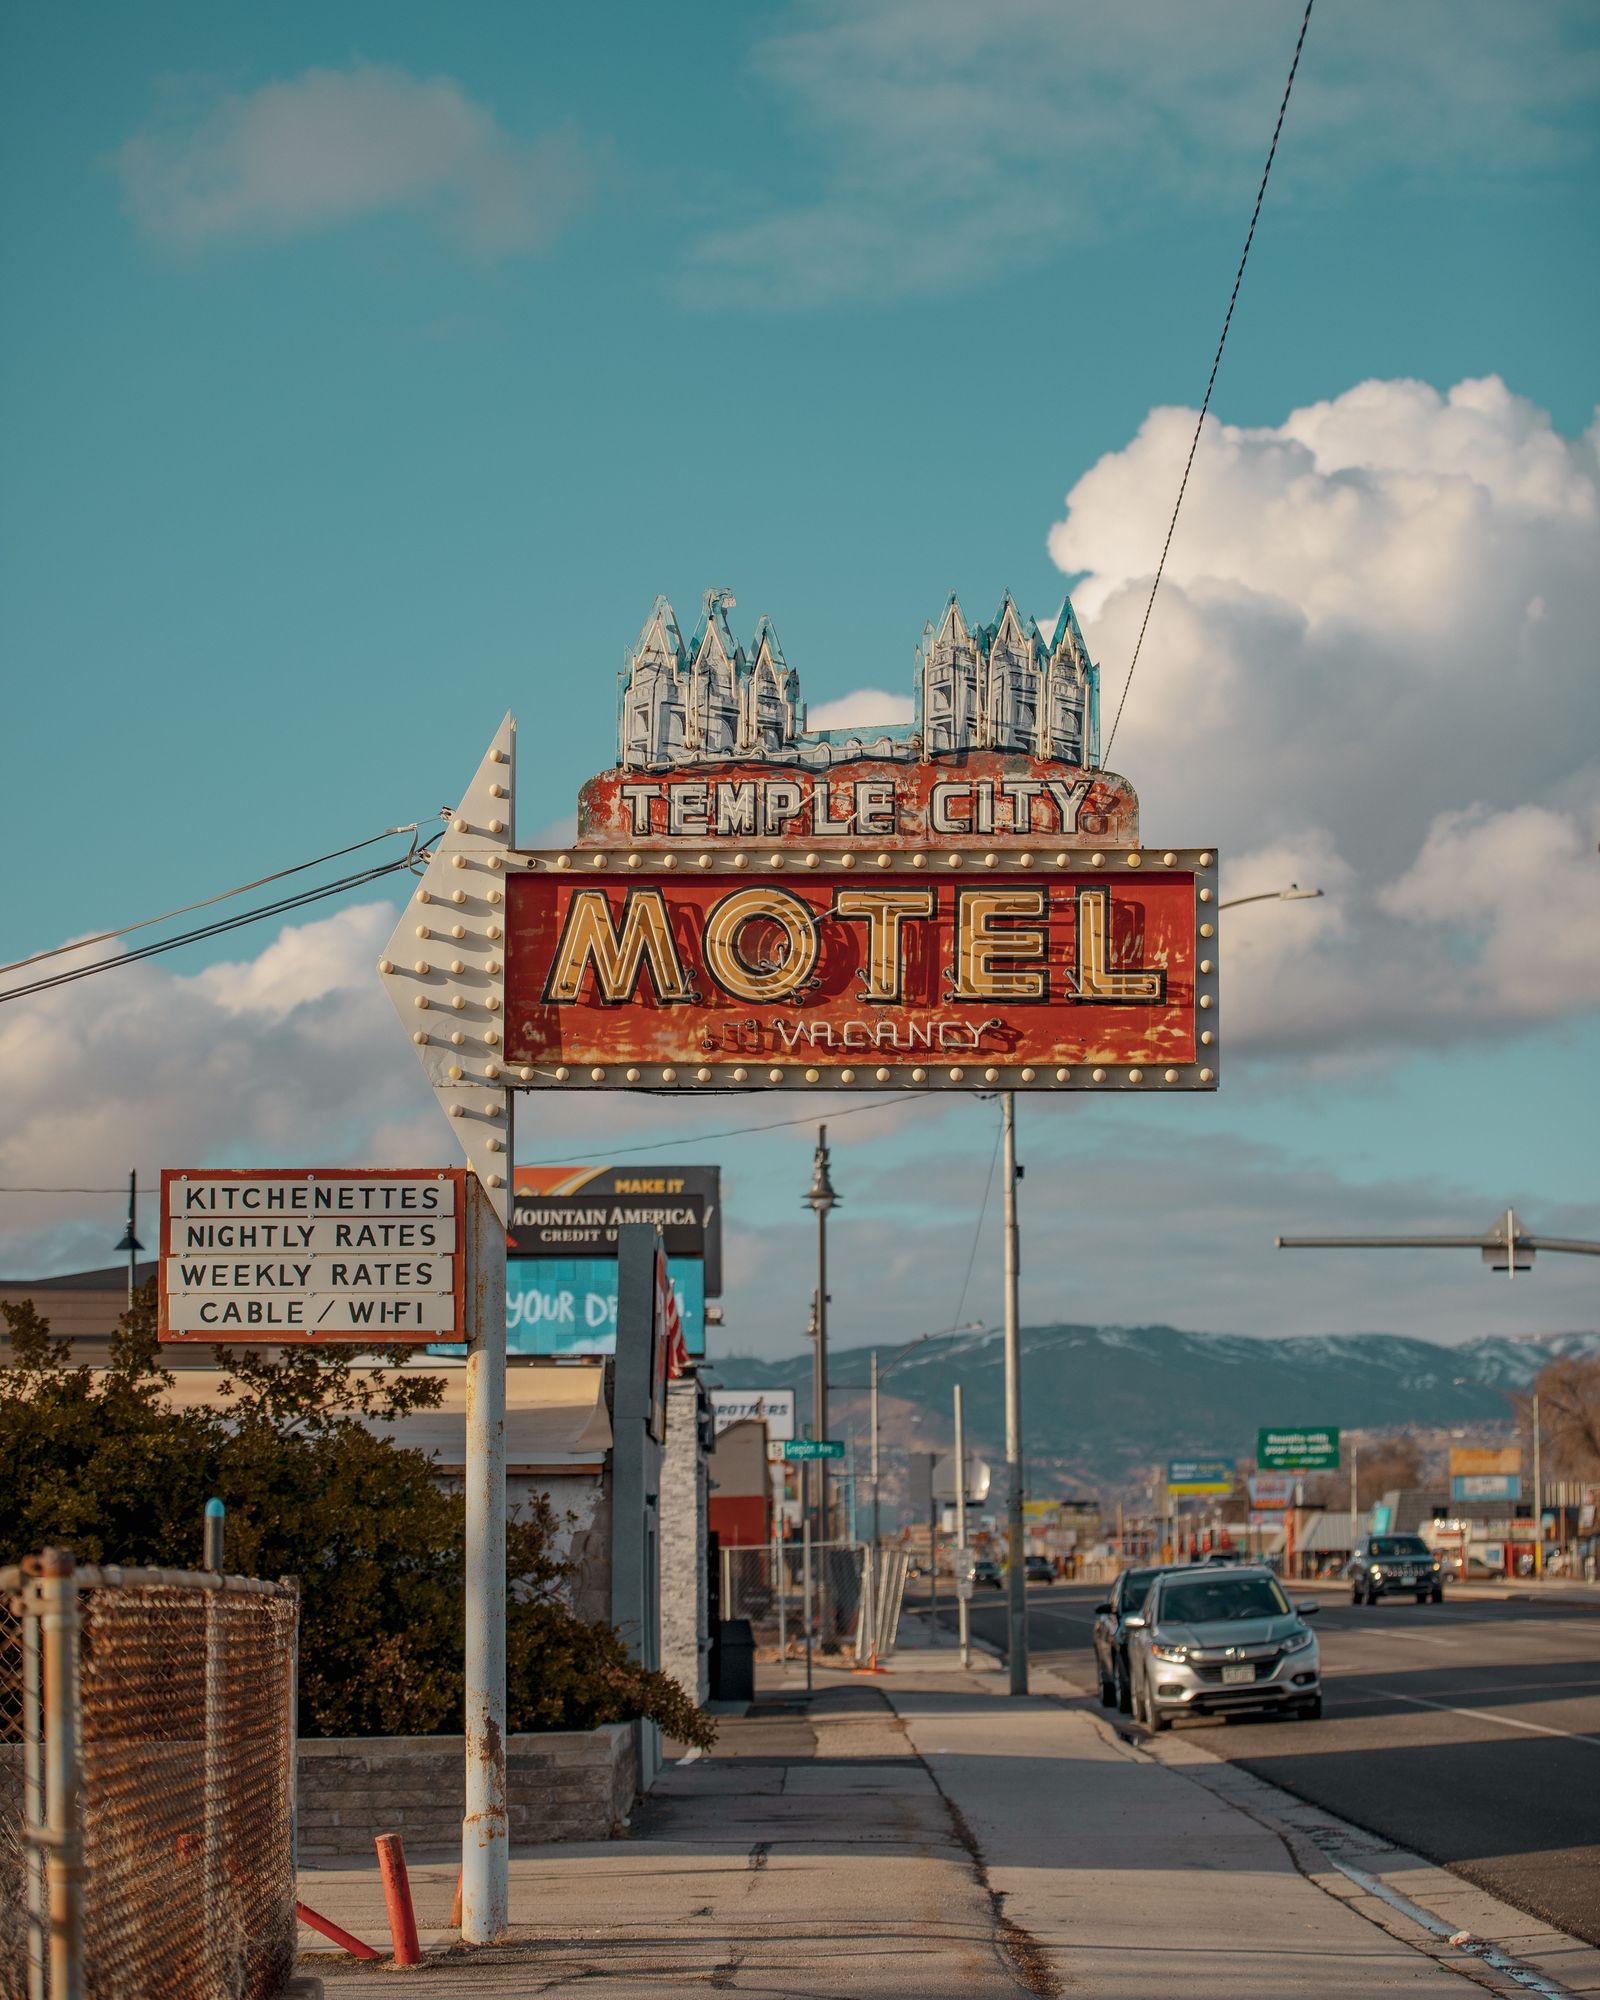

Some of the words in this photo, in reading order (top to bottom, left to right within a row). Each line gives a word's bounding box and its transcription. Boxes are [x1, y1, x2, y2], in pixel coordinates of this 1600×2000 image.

[621, 781, 895, 837] TEMPLE
[929, 779, 1094, 836] CITY
[540, 885, 1168, 1006] MOTEL
[775, 1020, 992, 1048] VACANCY
[186, 1186, 441, 1210] KITCHENETTES
[614, 1179, 664, 1194] MAKE
[667, 1179, 685, 1193] IT
[187, 1225, 316, 1248] NIGHTLY
[335, 1224, 437, 1248] RATES
[540, 1228, 601, 1242] CREDIT
[181, 1263, 313, 1287] WEEKLY
[331, 1262, 434, 1286] RATES
[199, 1300, 304, 1325] CABLE
[317, 1299, 336, 1324] /
[348, 1300, 424, 1325] WI-FI
[506, 1289, 575, 1329] YOUR
